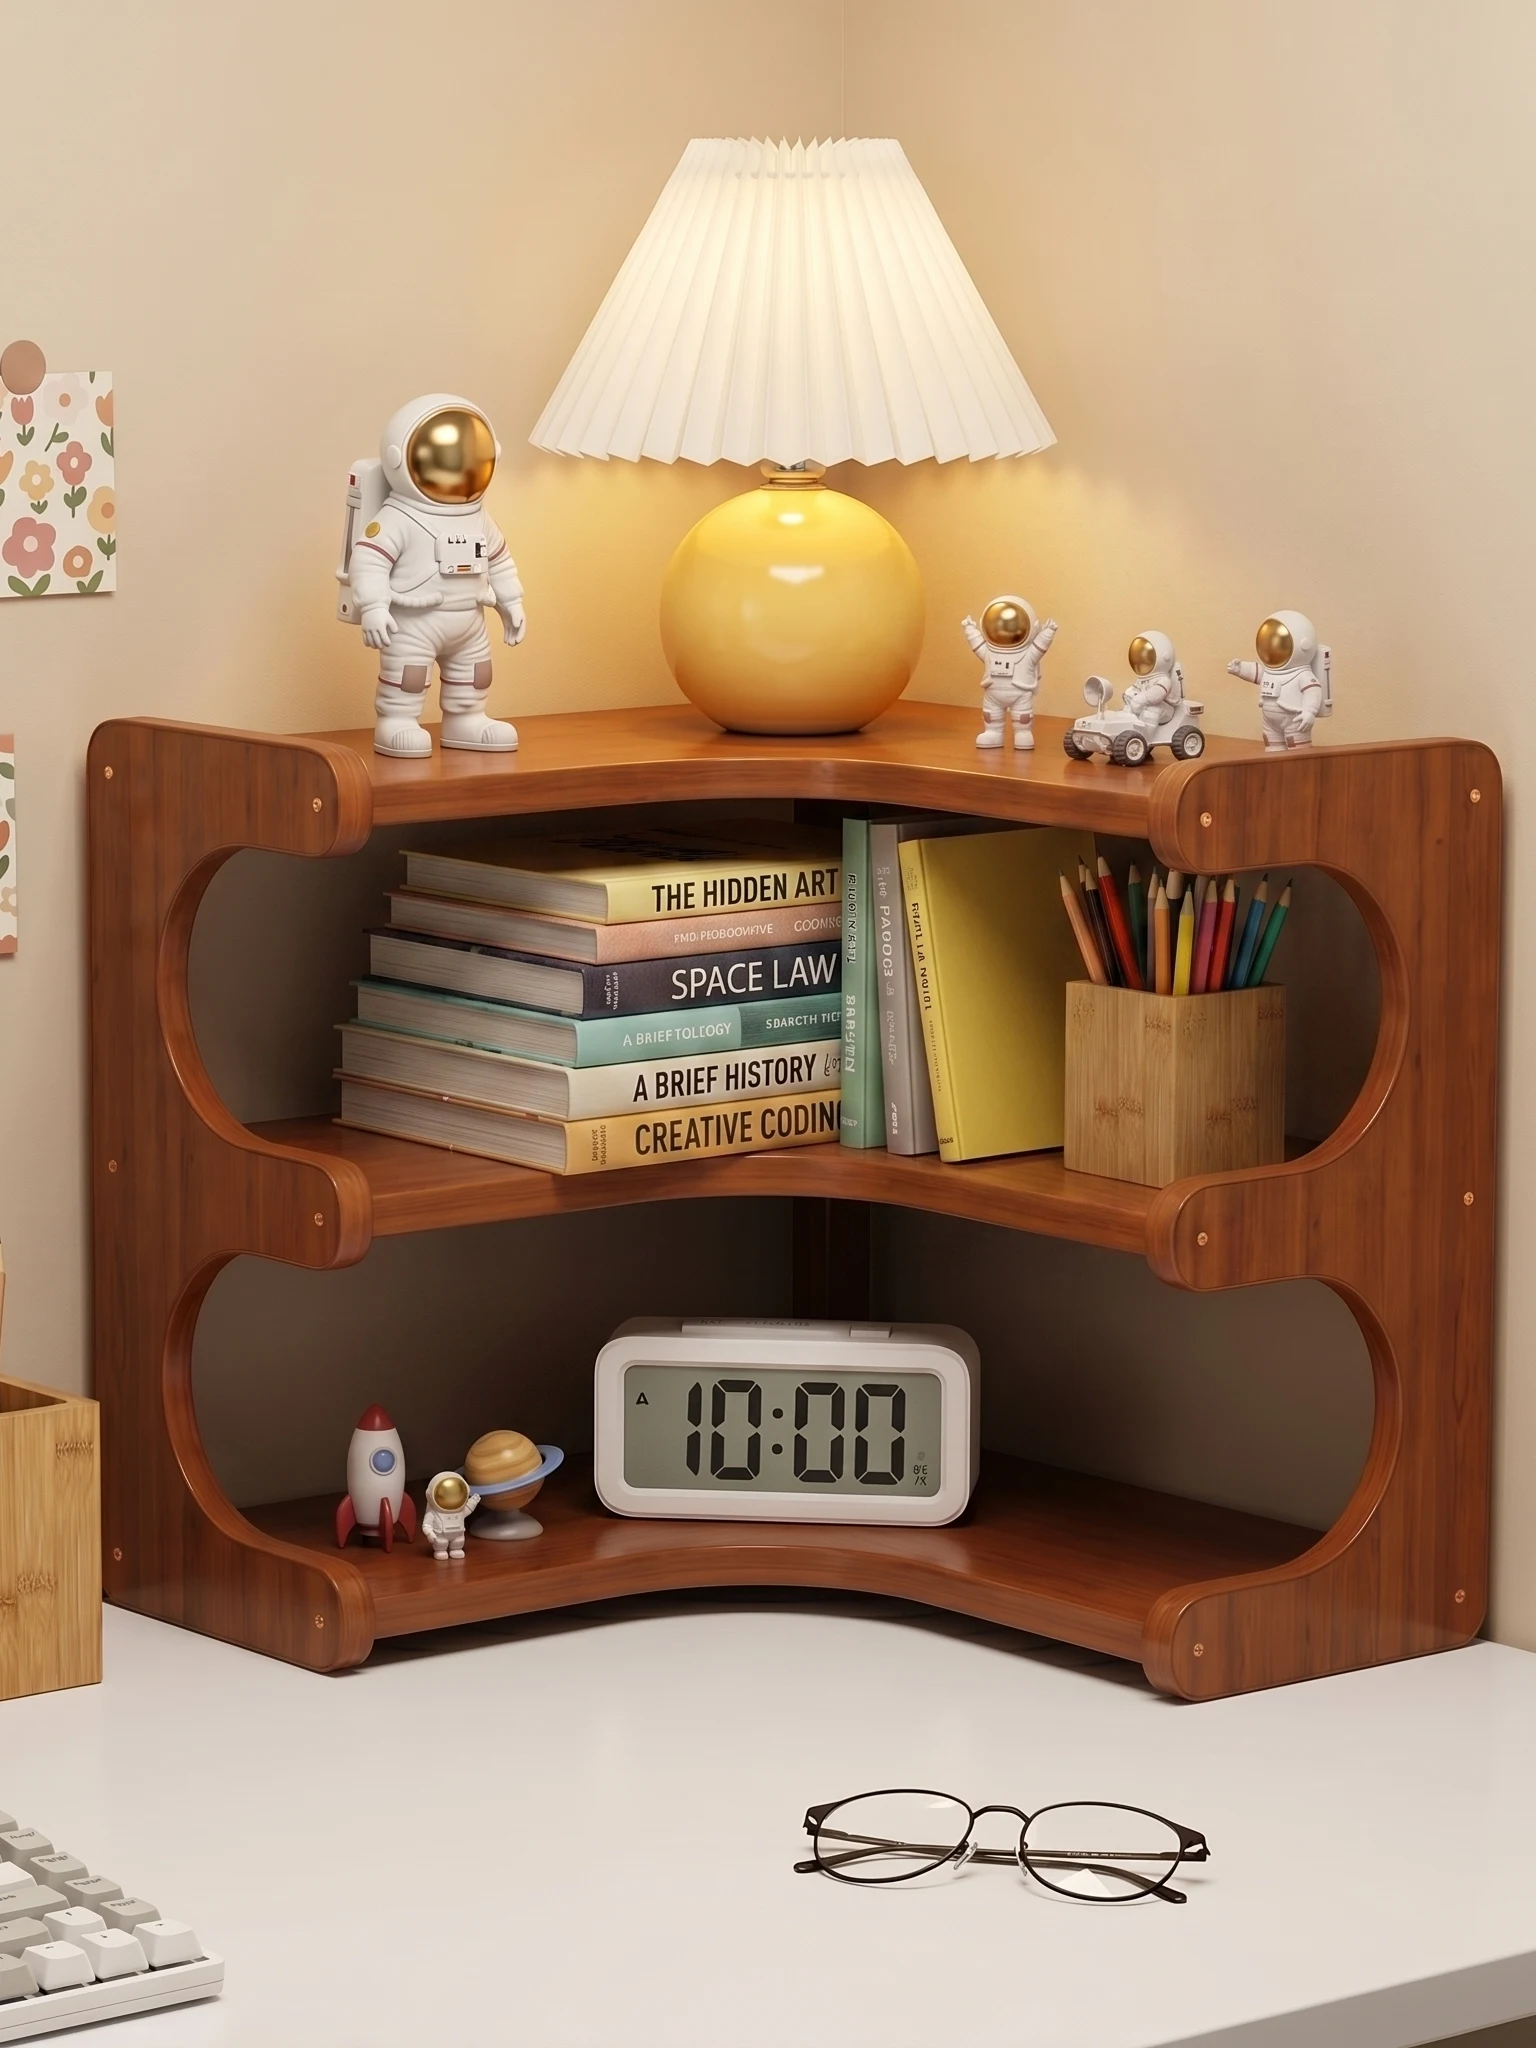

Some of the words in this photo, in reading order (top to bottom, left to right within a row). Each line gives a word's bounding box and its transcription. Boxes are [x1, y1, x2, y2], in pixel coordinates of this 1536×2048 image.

[651, 882, 696, 913] THE
[703, 872, 788, 908] HIDDEN
[794, 868, 839, 898] ART
[671, 961, 763, 1000] SPACE
[773, 953, 838, 989] LAW
[622, 1034, 633, 1047] A
[636, 1029, 673, 1045] BRIEF
[632, 1074, 649, 1103] A
[655, 1065, 719, 1100] BRIEF
[725, 1053, 817, 1092] HISTORY
[635, 1110, 753, 1156] CREATIVE
[635, 1392, 649, 1406] A
[686, 1379, 906, 1485] 10:00
